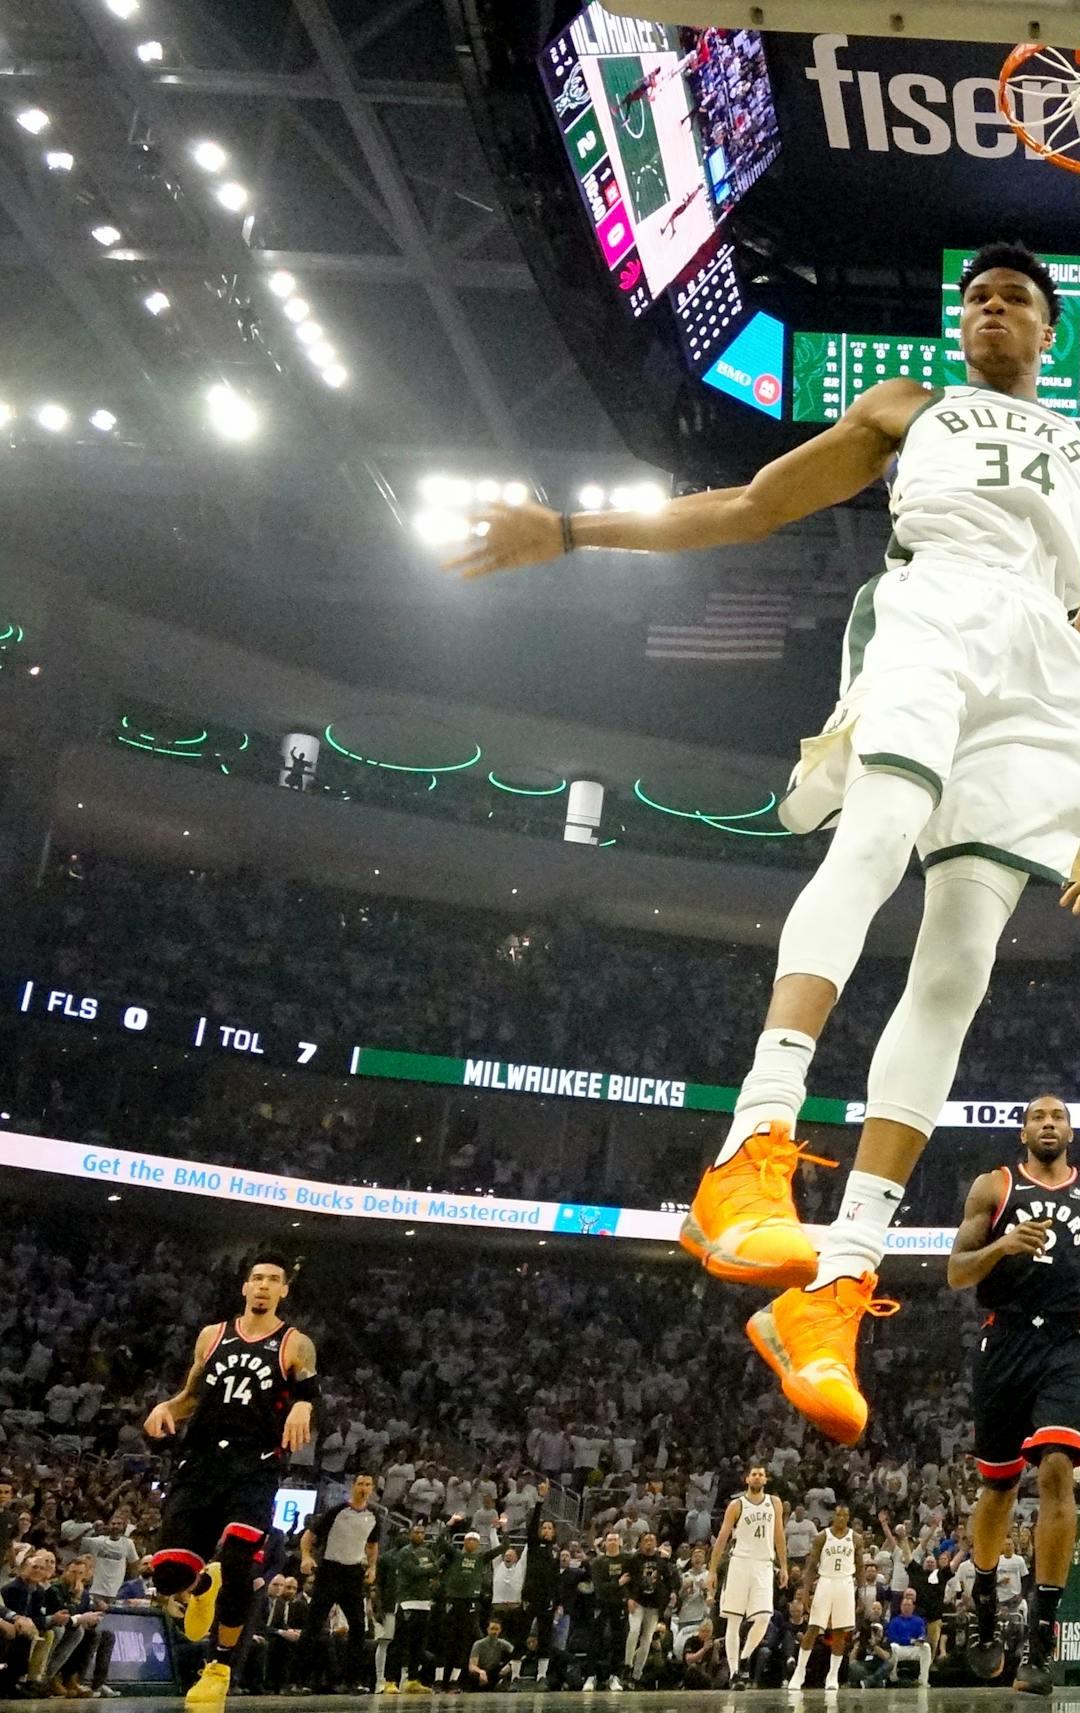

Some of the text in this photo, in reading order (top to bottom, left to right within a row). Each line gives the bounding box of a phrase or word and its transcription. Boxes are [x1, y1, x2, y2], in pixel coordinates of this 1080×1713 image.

[577, 130, 597, 158] 2
[584, 175, 606, 222] 10:40
[607, 221, 625, 248] 0
[716, 360, 752, 387] BMO
[975, 442, 1055, 496] 34
[47, 990, 318, 1064] FLS 0 TOL 7
[463, 1060, 866, 1122] MILWAUKEE BUCKS 2
[963, 1105, 1024, 1126] 10:4
[82, 1153, 541, 1226] Get the BMO Harris Bucks Debit Mastercard
[886, 1232, 954, 1250] Conside
[1033, 1228, 1058, 1265] 2
[206, 1354, 273, 1390] RAPTORS
[223, 1376, 252, 1405] 14
[744, 1511, 773, 1525] BUCKS
[754, 1525, 765, 1539] 41
[826, 1545, 853, 1557] BUCKS
[834, 1559, 842, 1571] 6
